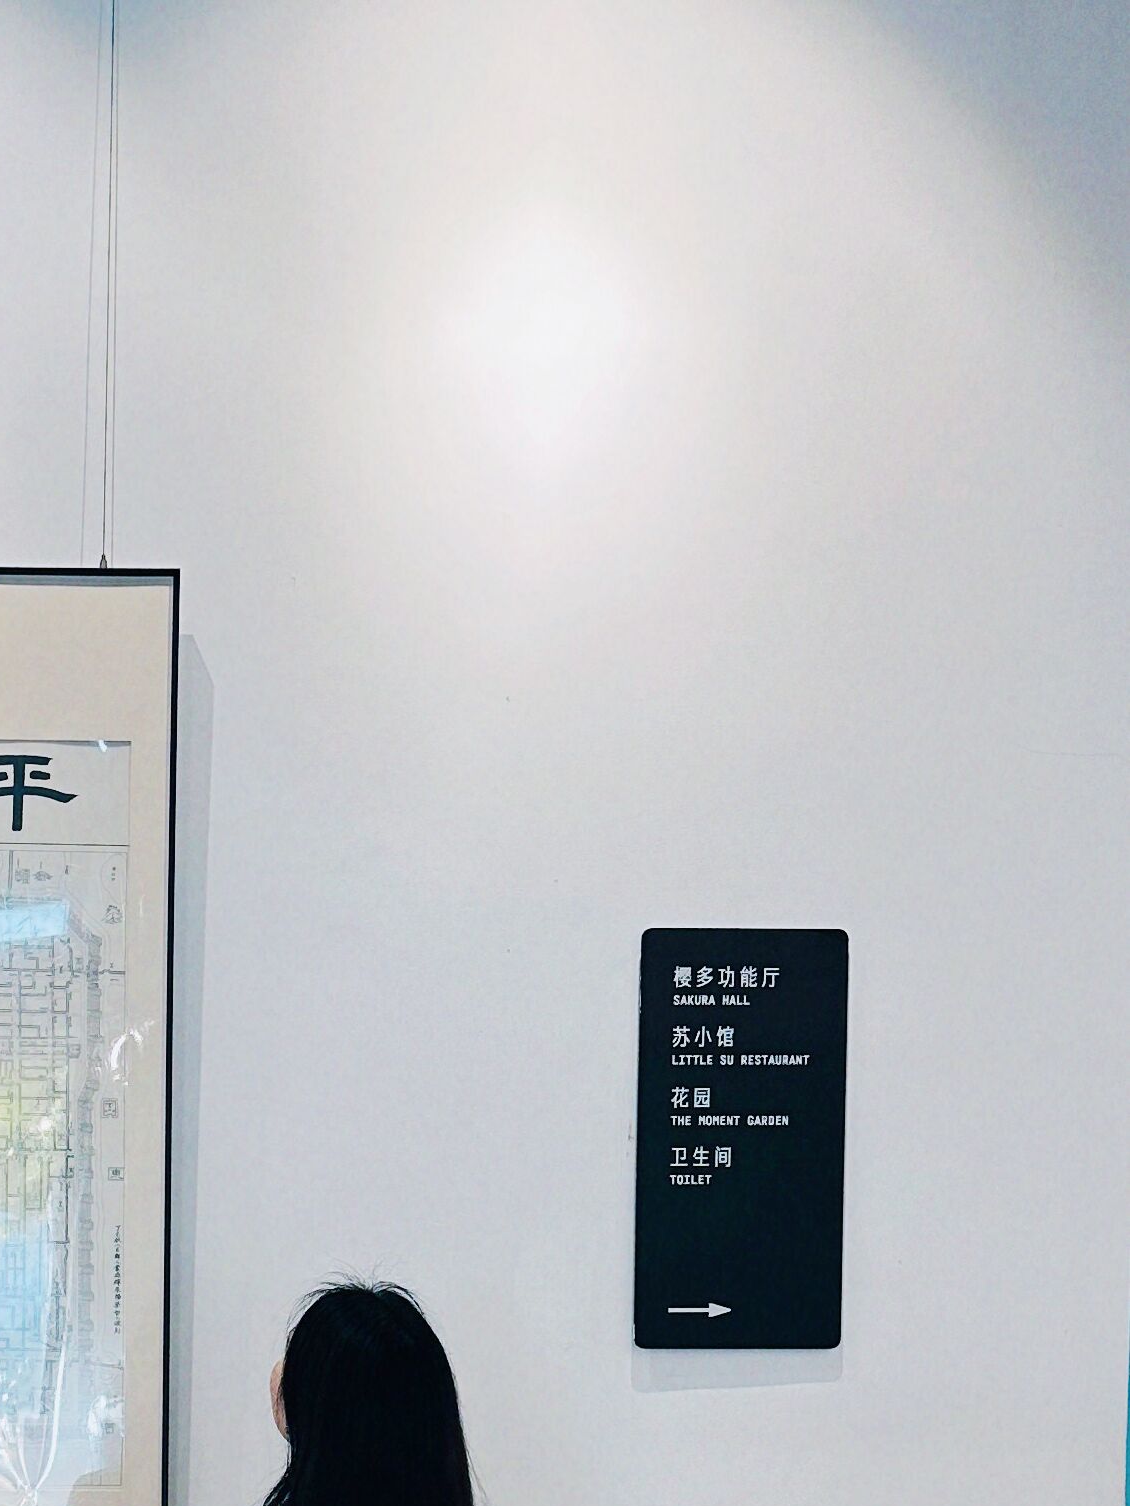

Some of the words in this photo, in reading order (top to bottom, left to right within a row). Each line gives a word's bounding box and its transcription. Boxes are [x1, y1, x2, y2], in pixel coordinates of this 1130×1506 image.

[673, 965, 780, 989] 樱多功能厅
[673, 994, 716, 1006] SAKURA
[722, 994, 751, 1006] HALL
[672, 1025, 735, 1048] 苏小馆
[671, 1054, 714, 1066] LITTLE
[720, 1054, 735, 1066] SU
[740, 1054, 811, 1066] RESTAURANT
[671, 1086, 711, 1108] 花园
[670, 1115, 692, 1126] THE
[698, 1115, 741, 1126] MOMENT
[747, 1115, 789, 1126] GARDEN
[670, 1145, 732, 1168] 卫生间
[670, 1174, 713, 1186] TOILET
